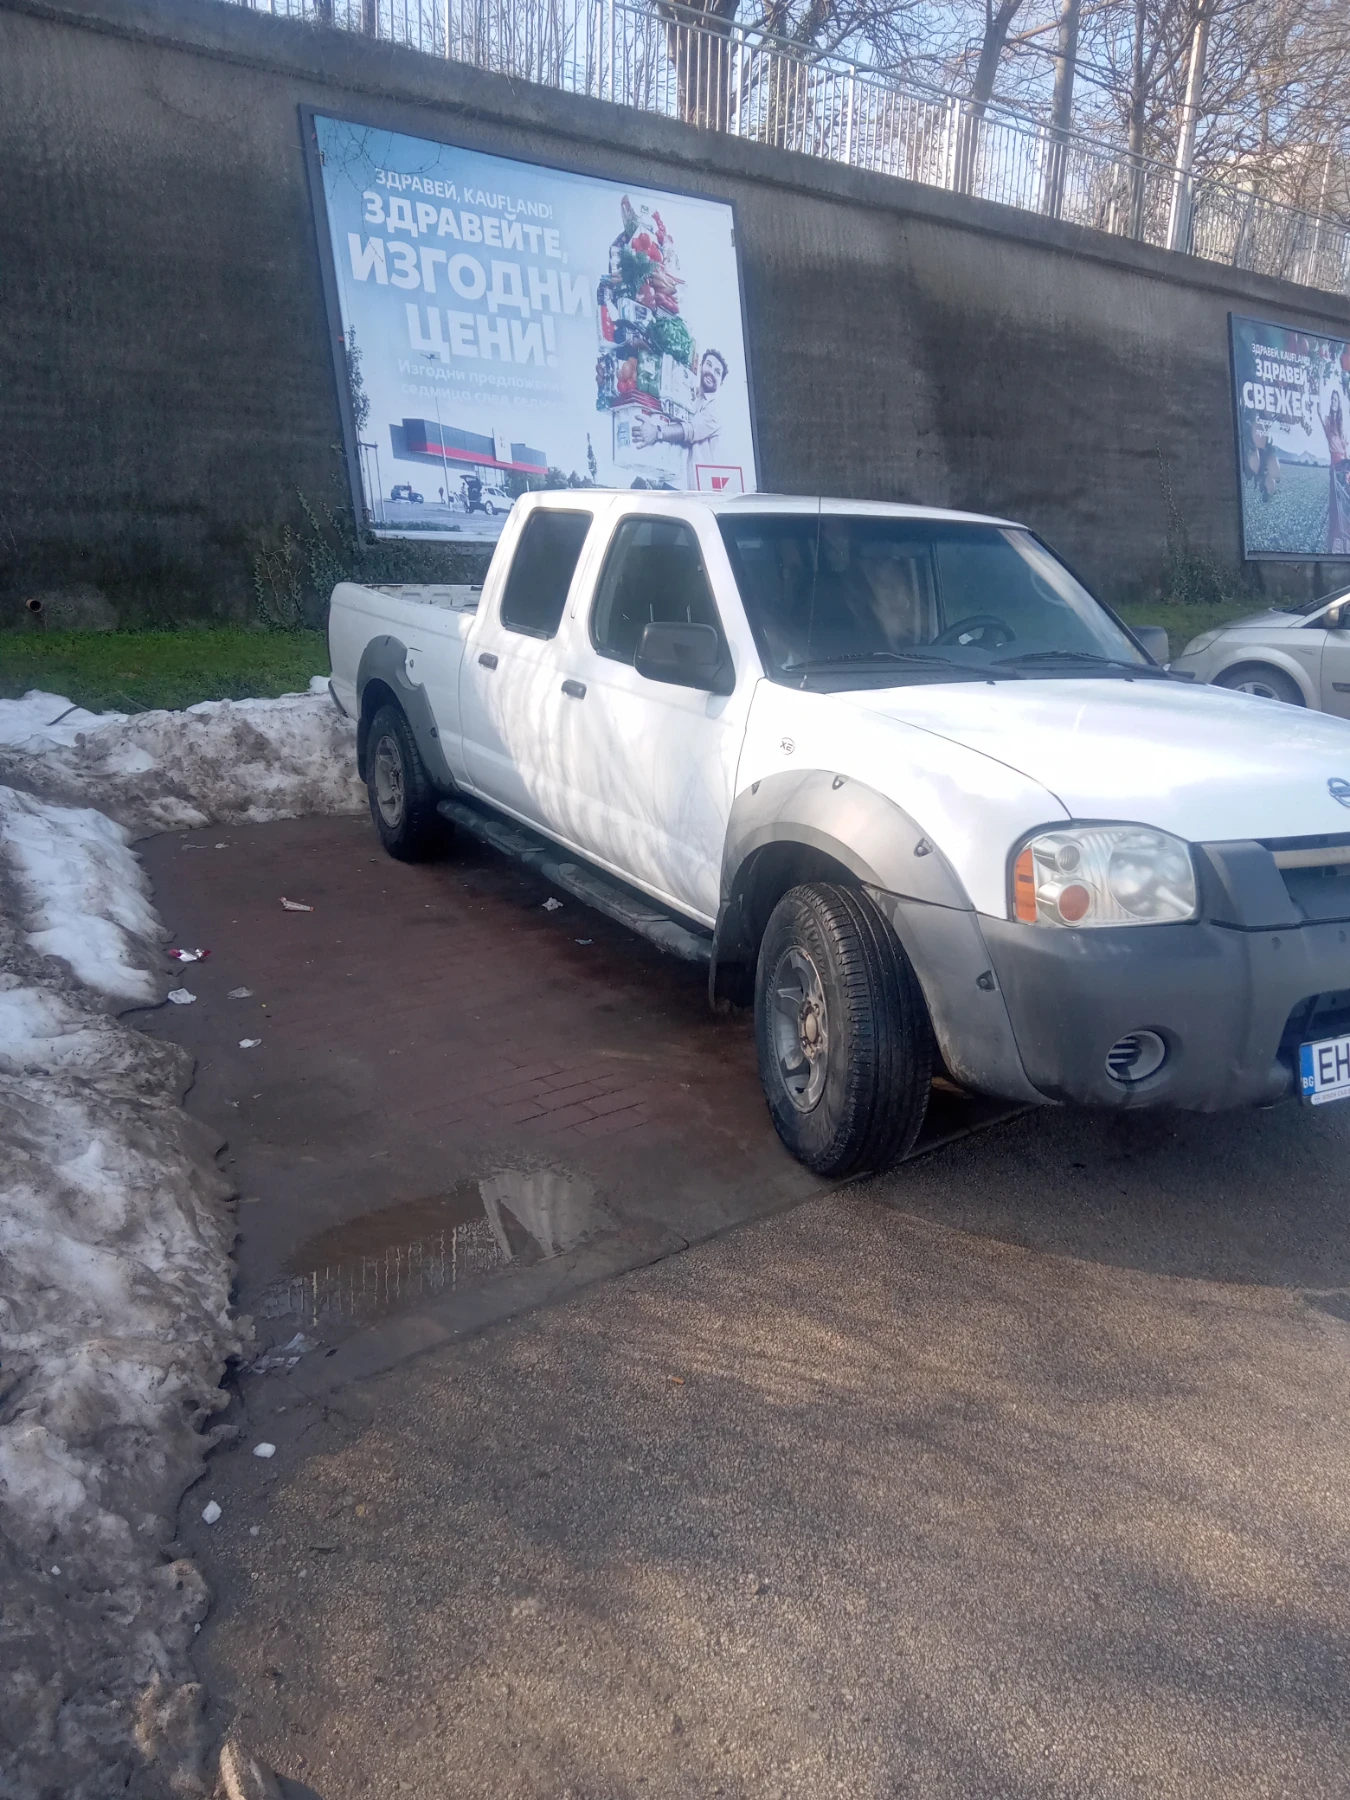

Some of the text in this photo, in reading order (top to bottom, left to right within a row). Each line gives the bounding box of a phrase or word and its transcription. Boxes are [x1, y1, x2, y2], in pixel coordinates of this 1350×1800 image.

[375, 167, 554, 220] ЗДРАВЕЙ, KAUFLAND!
[362, 190, 569, 264] ЗДРАВЕЙТЕ,
[347, 232, 593, 319] ИЗГОДНИ
[405, 302, 559, 369] ЦЕНИ!
[399, 359, 465, 382] Изгодни
[1303, 1077, 1314, 1089] BG
